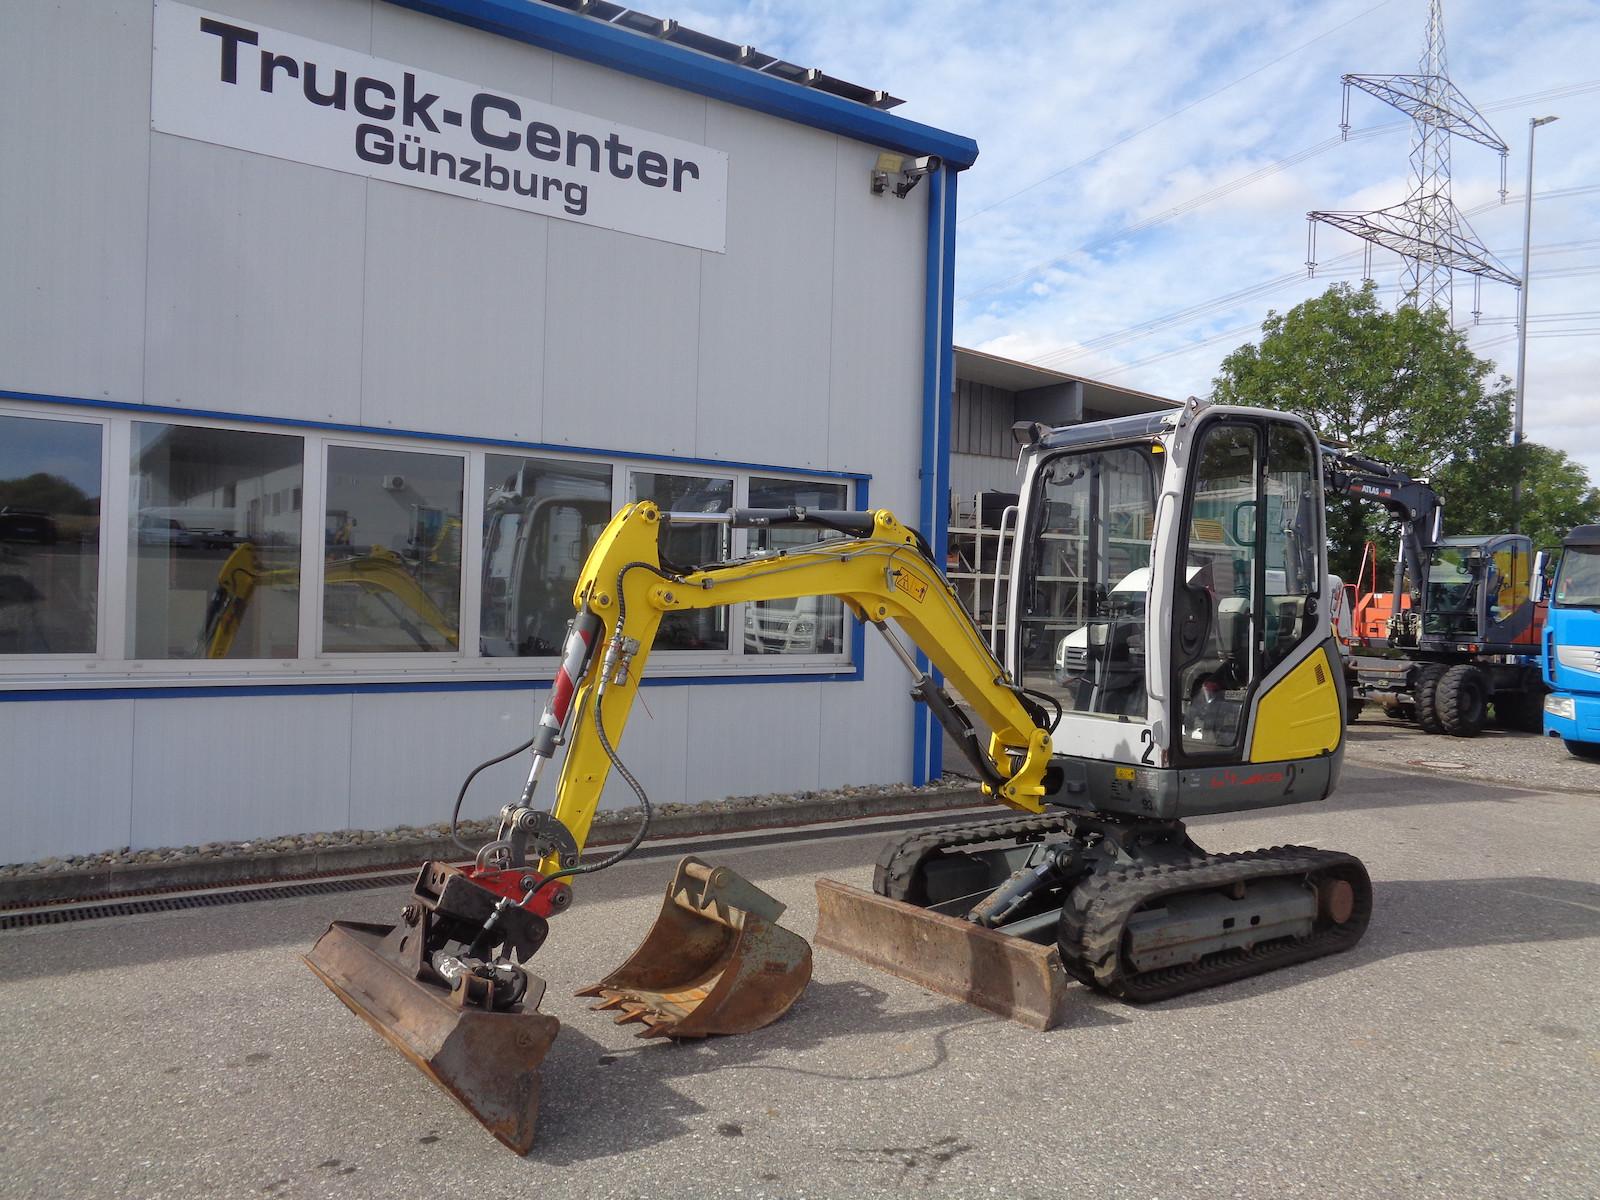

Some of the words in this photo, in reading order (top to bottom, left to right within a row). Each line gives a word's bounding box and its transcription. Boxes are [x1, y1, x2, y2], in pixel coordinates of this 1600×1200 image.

[200, 16, 700, 193] Truck-Center
[355, 123, 588, 217] Günzburg
[1361, 484, 1380, 495] ATLAS
[1141, 729, 1154, 766] 2
[1283, 763, 1296, 795] 2
